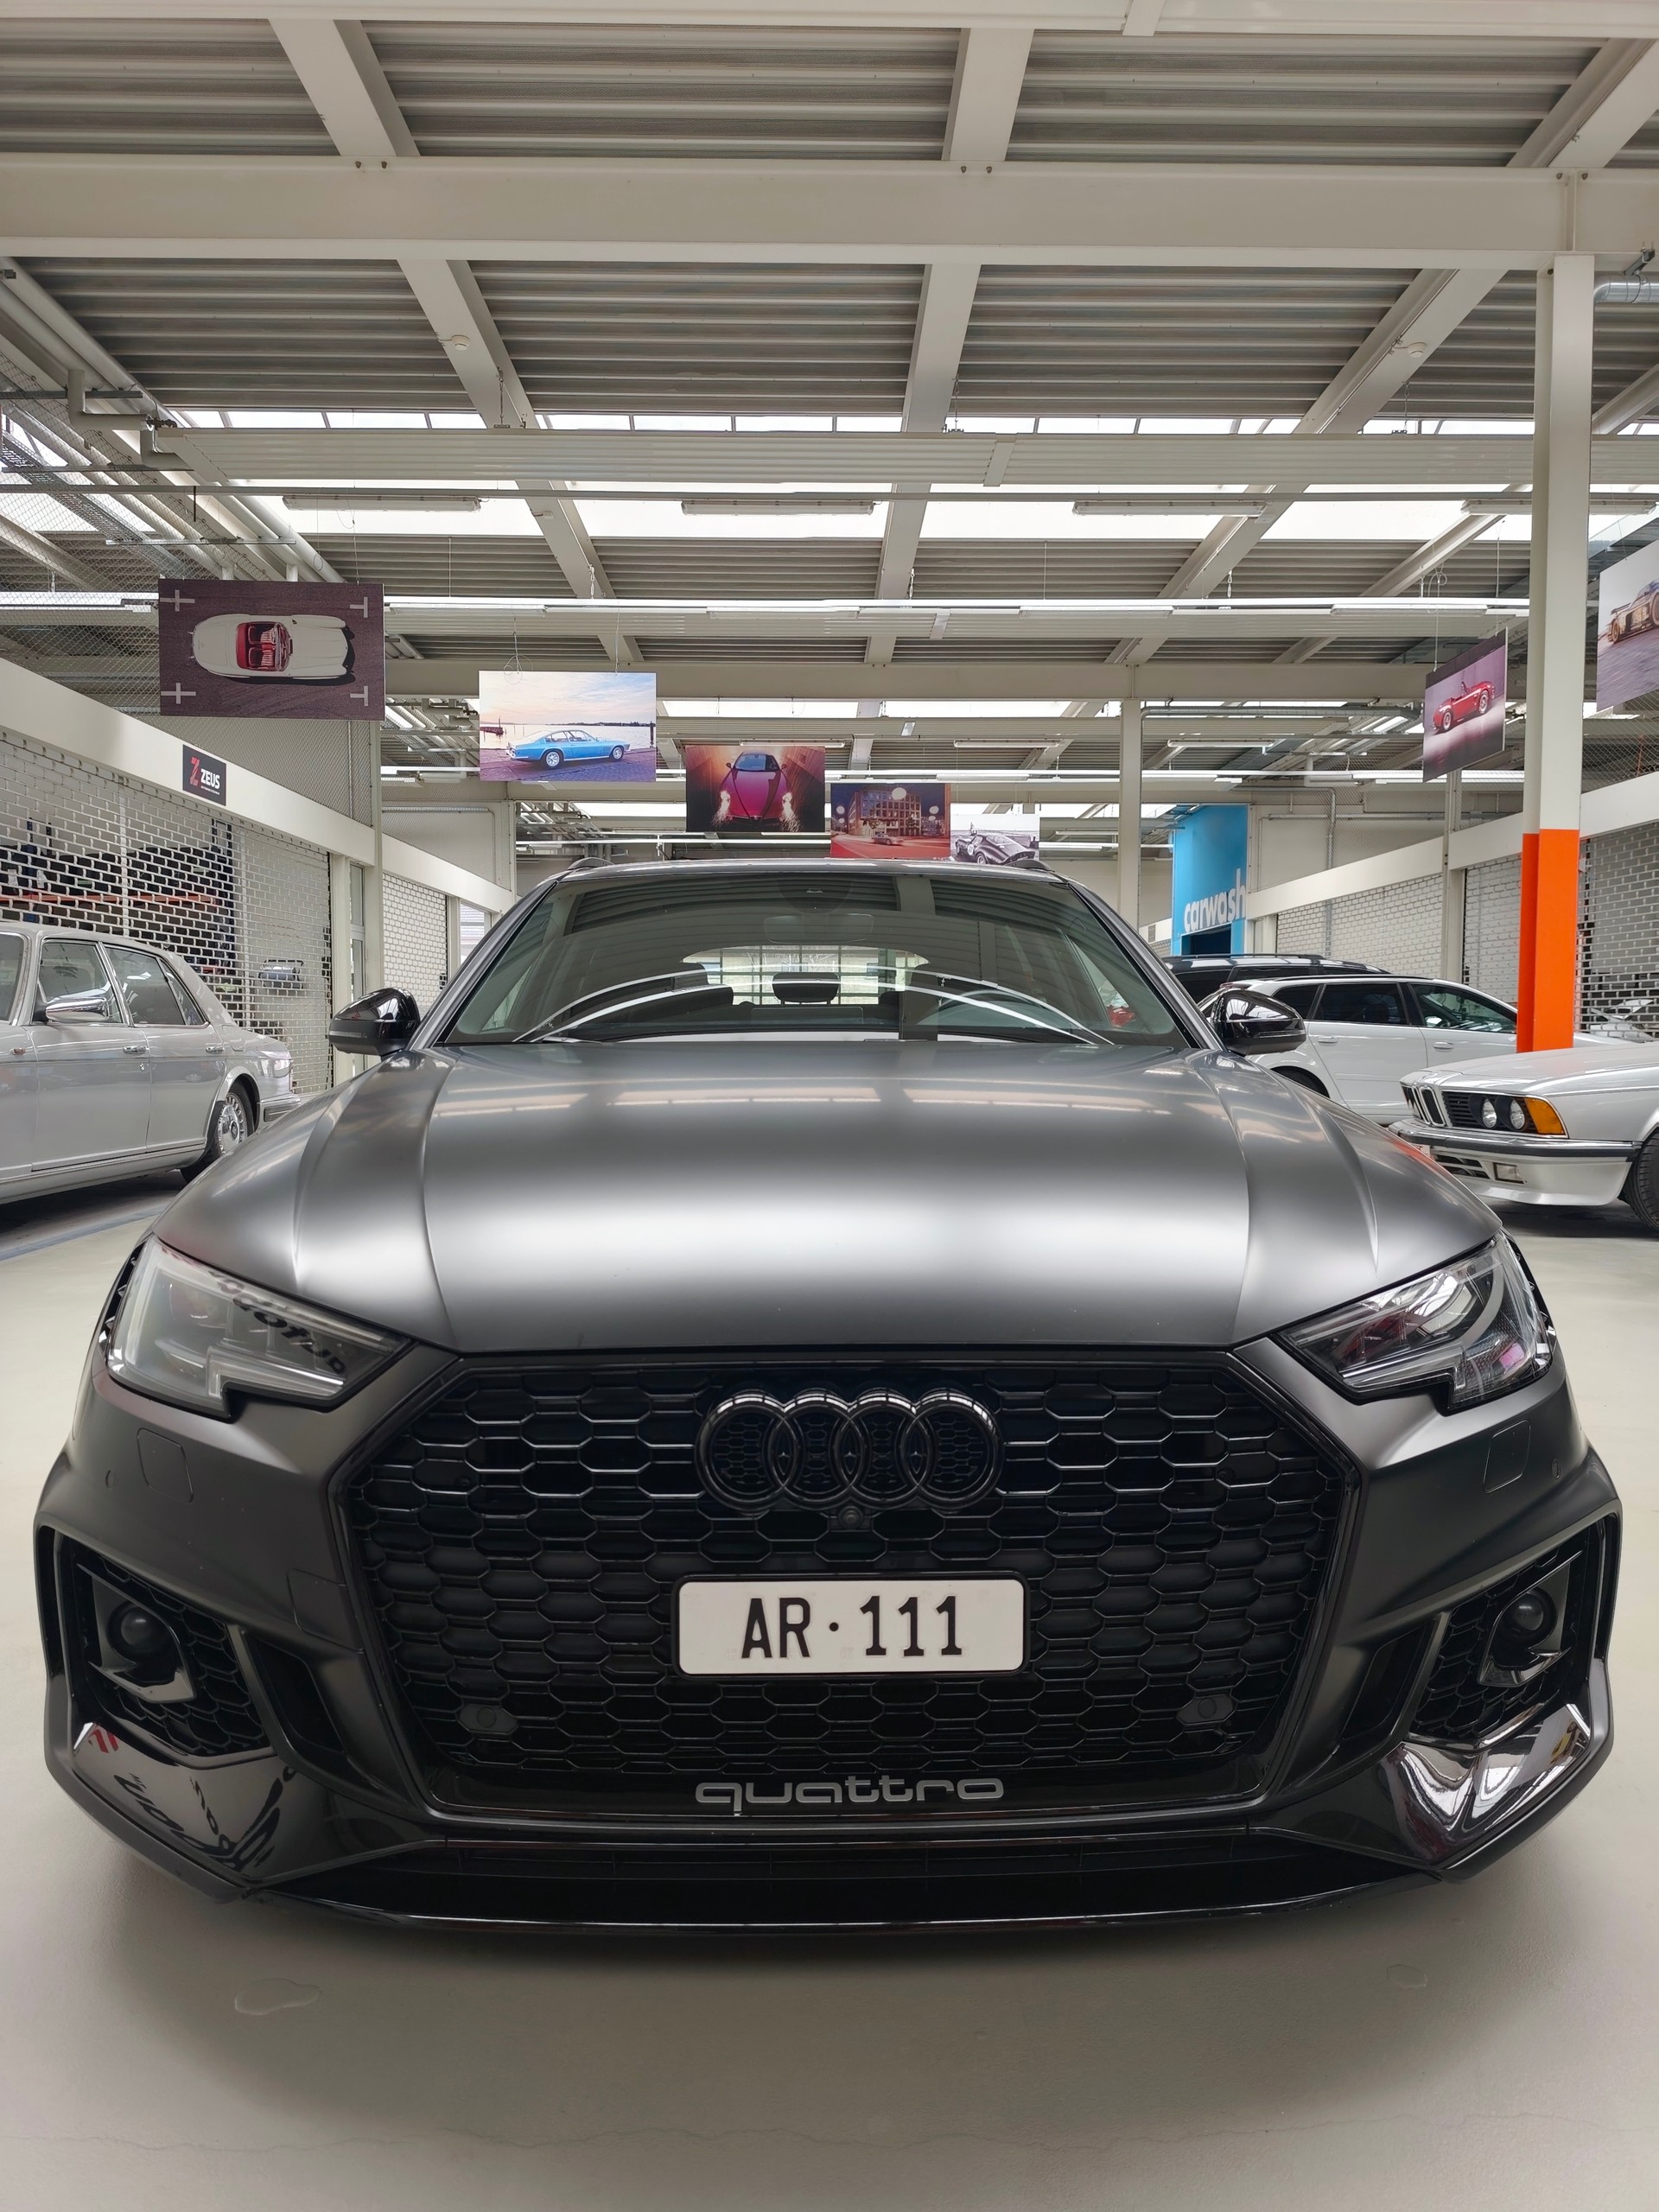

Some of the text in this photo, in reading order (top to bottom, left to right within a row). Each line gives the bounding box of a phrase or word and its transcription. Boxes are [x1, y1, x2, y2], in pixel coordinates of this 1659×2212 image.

[200, 768, 220, 789] ZEUS
[1184, 868, 1246, 933] carwash
[695, 1775, 1004, 1812] quattro
